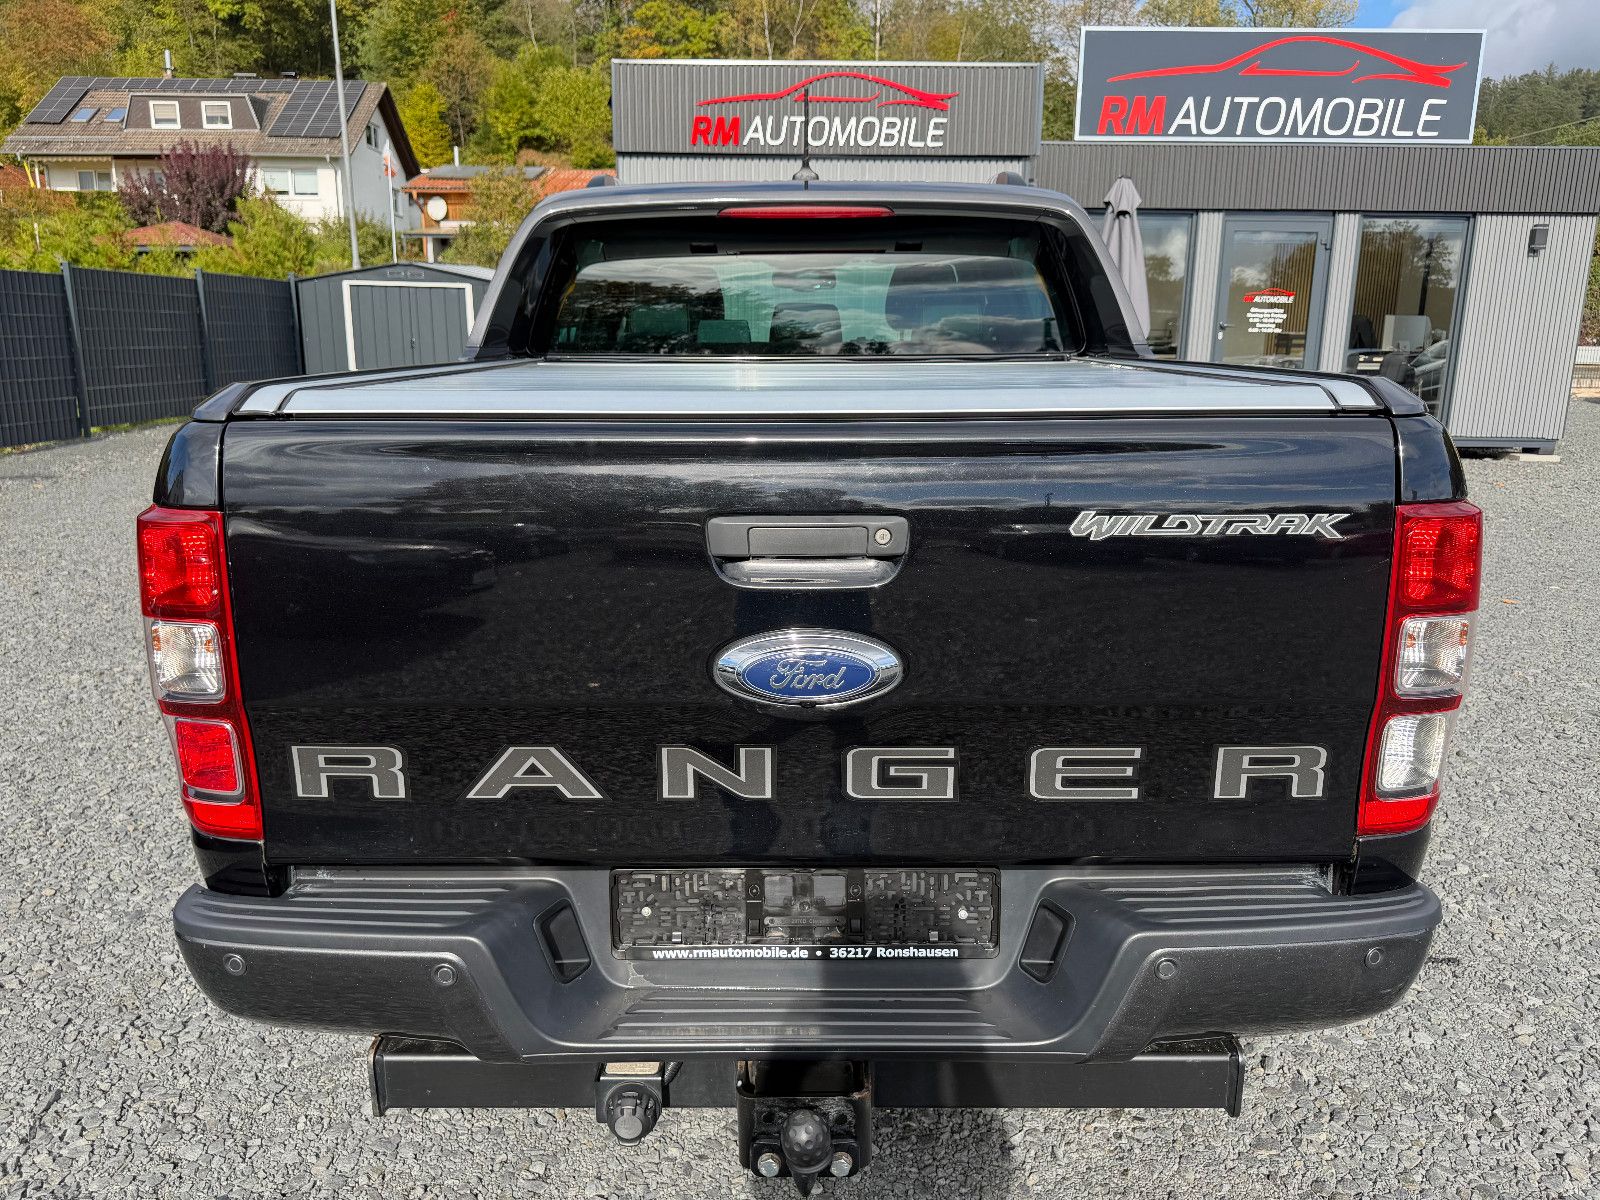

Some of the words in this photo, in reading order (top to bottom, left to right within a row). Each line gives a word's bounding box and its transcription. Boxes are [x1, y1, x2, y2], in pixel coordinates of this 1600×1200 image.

[690, 115, 740, 147] RM
[742, 115, 948, 148] AUTOMOBILE
[1097, 95, 1167, 135] RM
[1168, 96, 1448, 136] AUTOMOBILE
[1254, 295, 1294, 303] AUTOMOBILE
[1069, 511, 1350, 541] WILDTRAK
[769, 658, 846, 690] Ford
[291, 745, 1327, 801] RANGER
[652, 947, 808, 960] www.rmautomobile.de
[829, 947, 871, 959] 36217
[877, 946, 959, 958] Ronshausen
